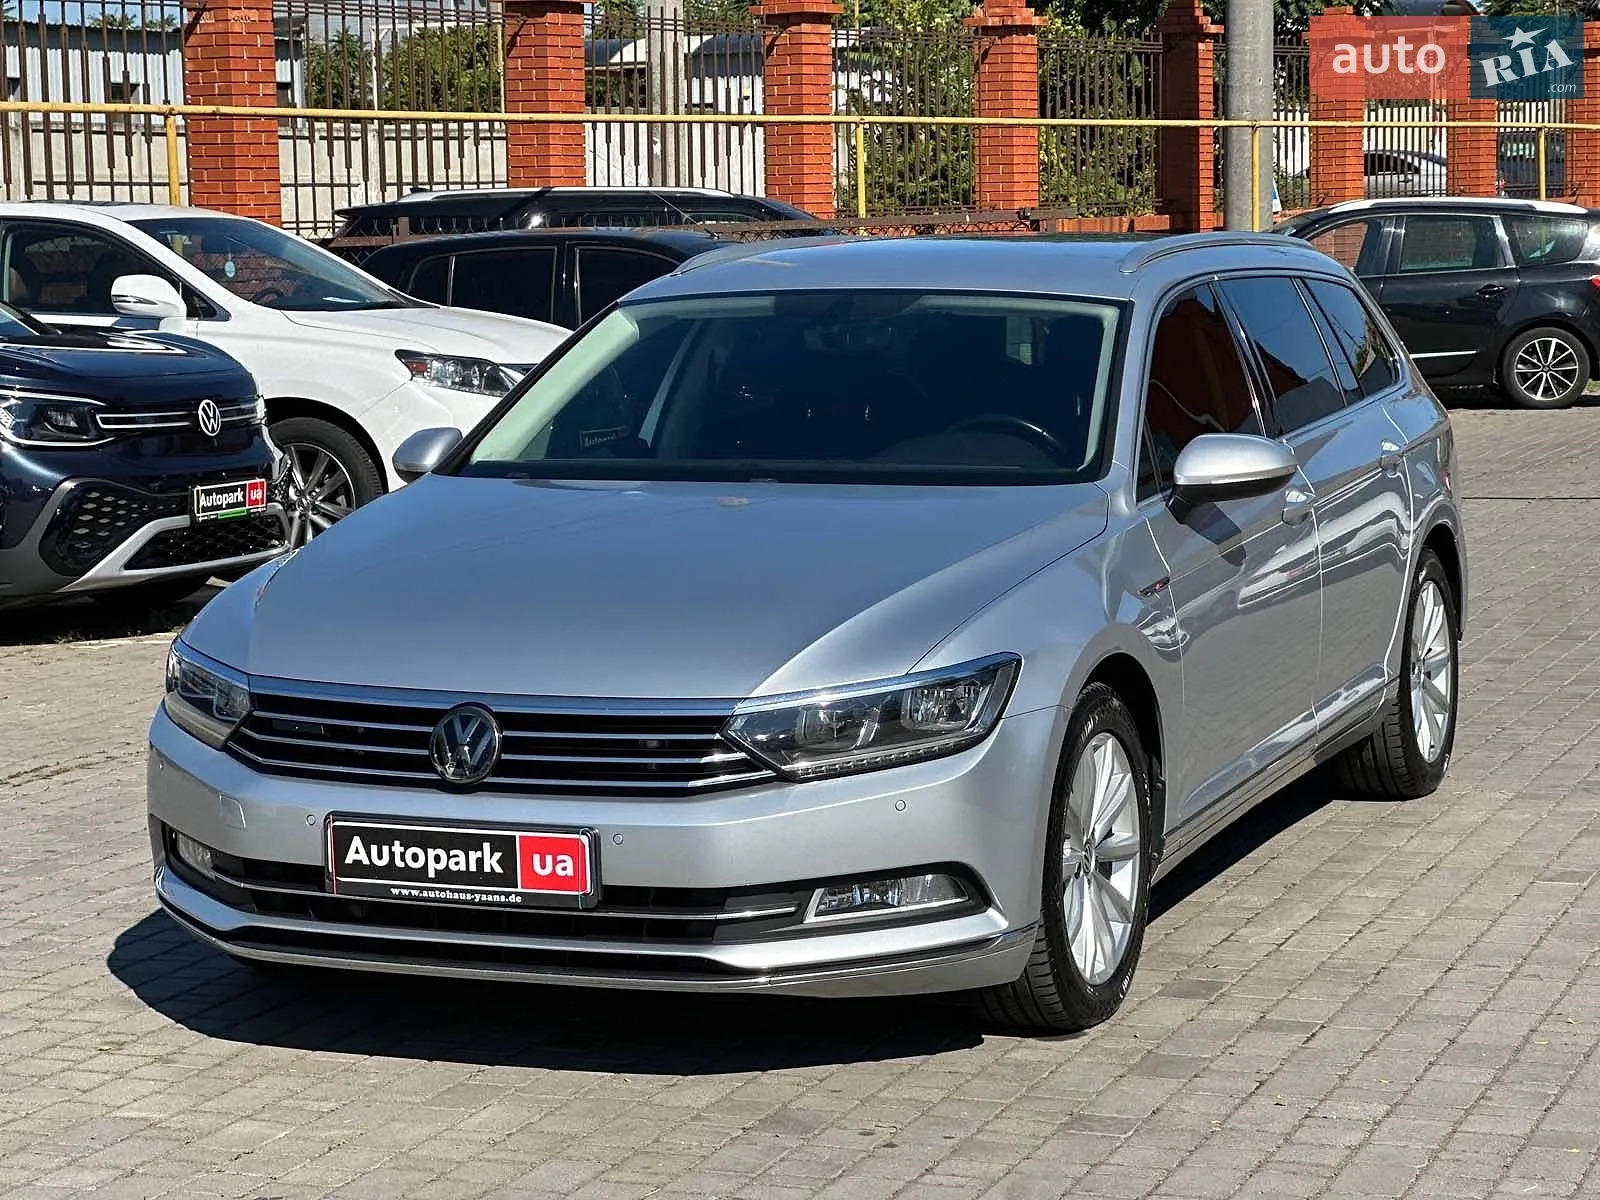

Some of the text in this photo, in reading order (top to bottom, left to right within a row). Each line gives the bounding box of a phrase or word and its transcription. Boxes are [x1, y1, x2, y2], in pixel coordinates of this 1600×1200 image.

[200, 487, 263, 508] Autopark ua
[344, 835, 574, 878] Autopark ua
[390, 887, 522, 903] www.autohaus-yaans.de
